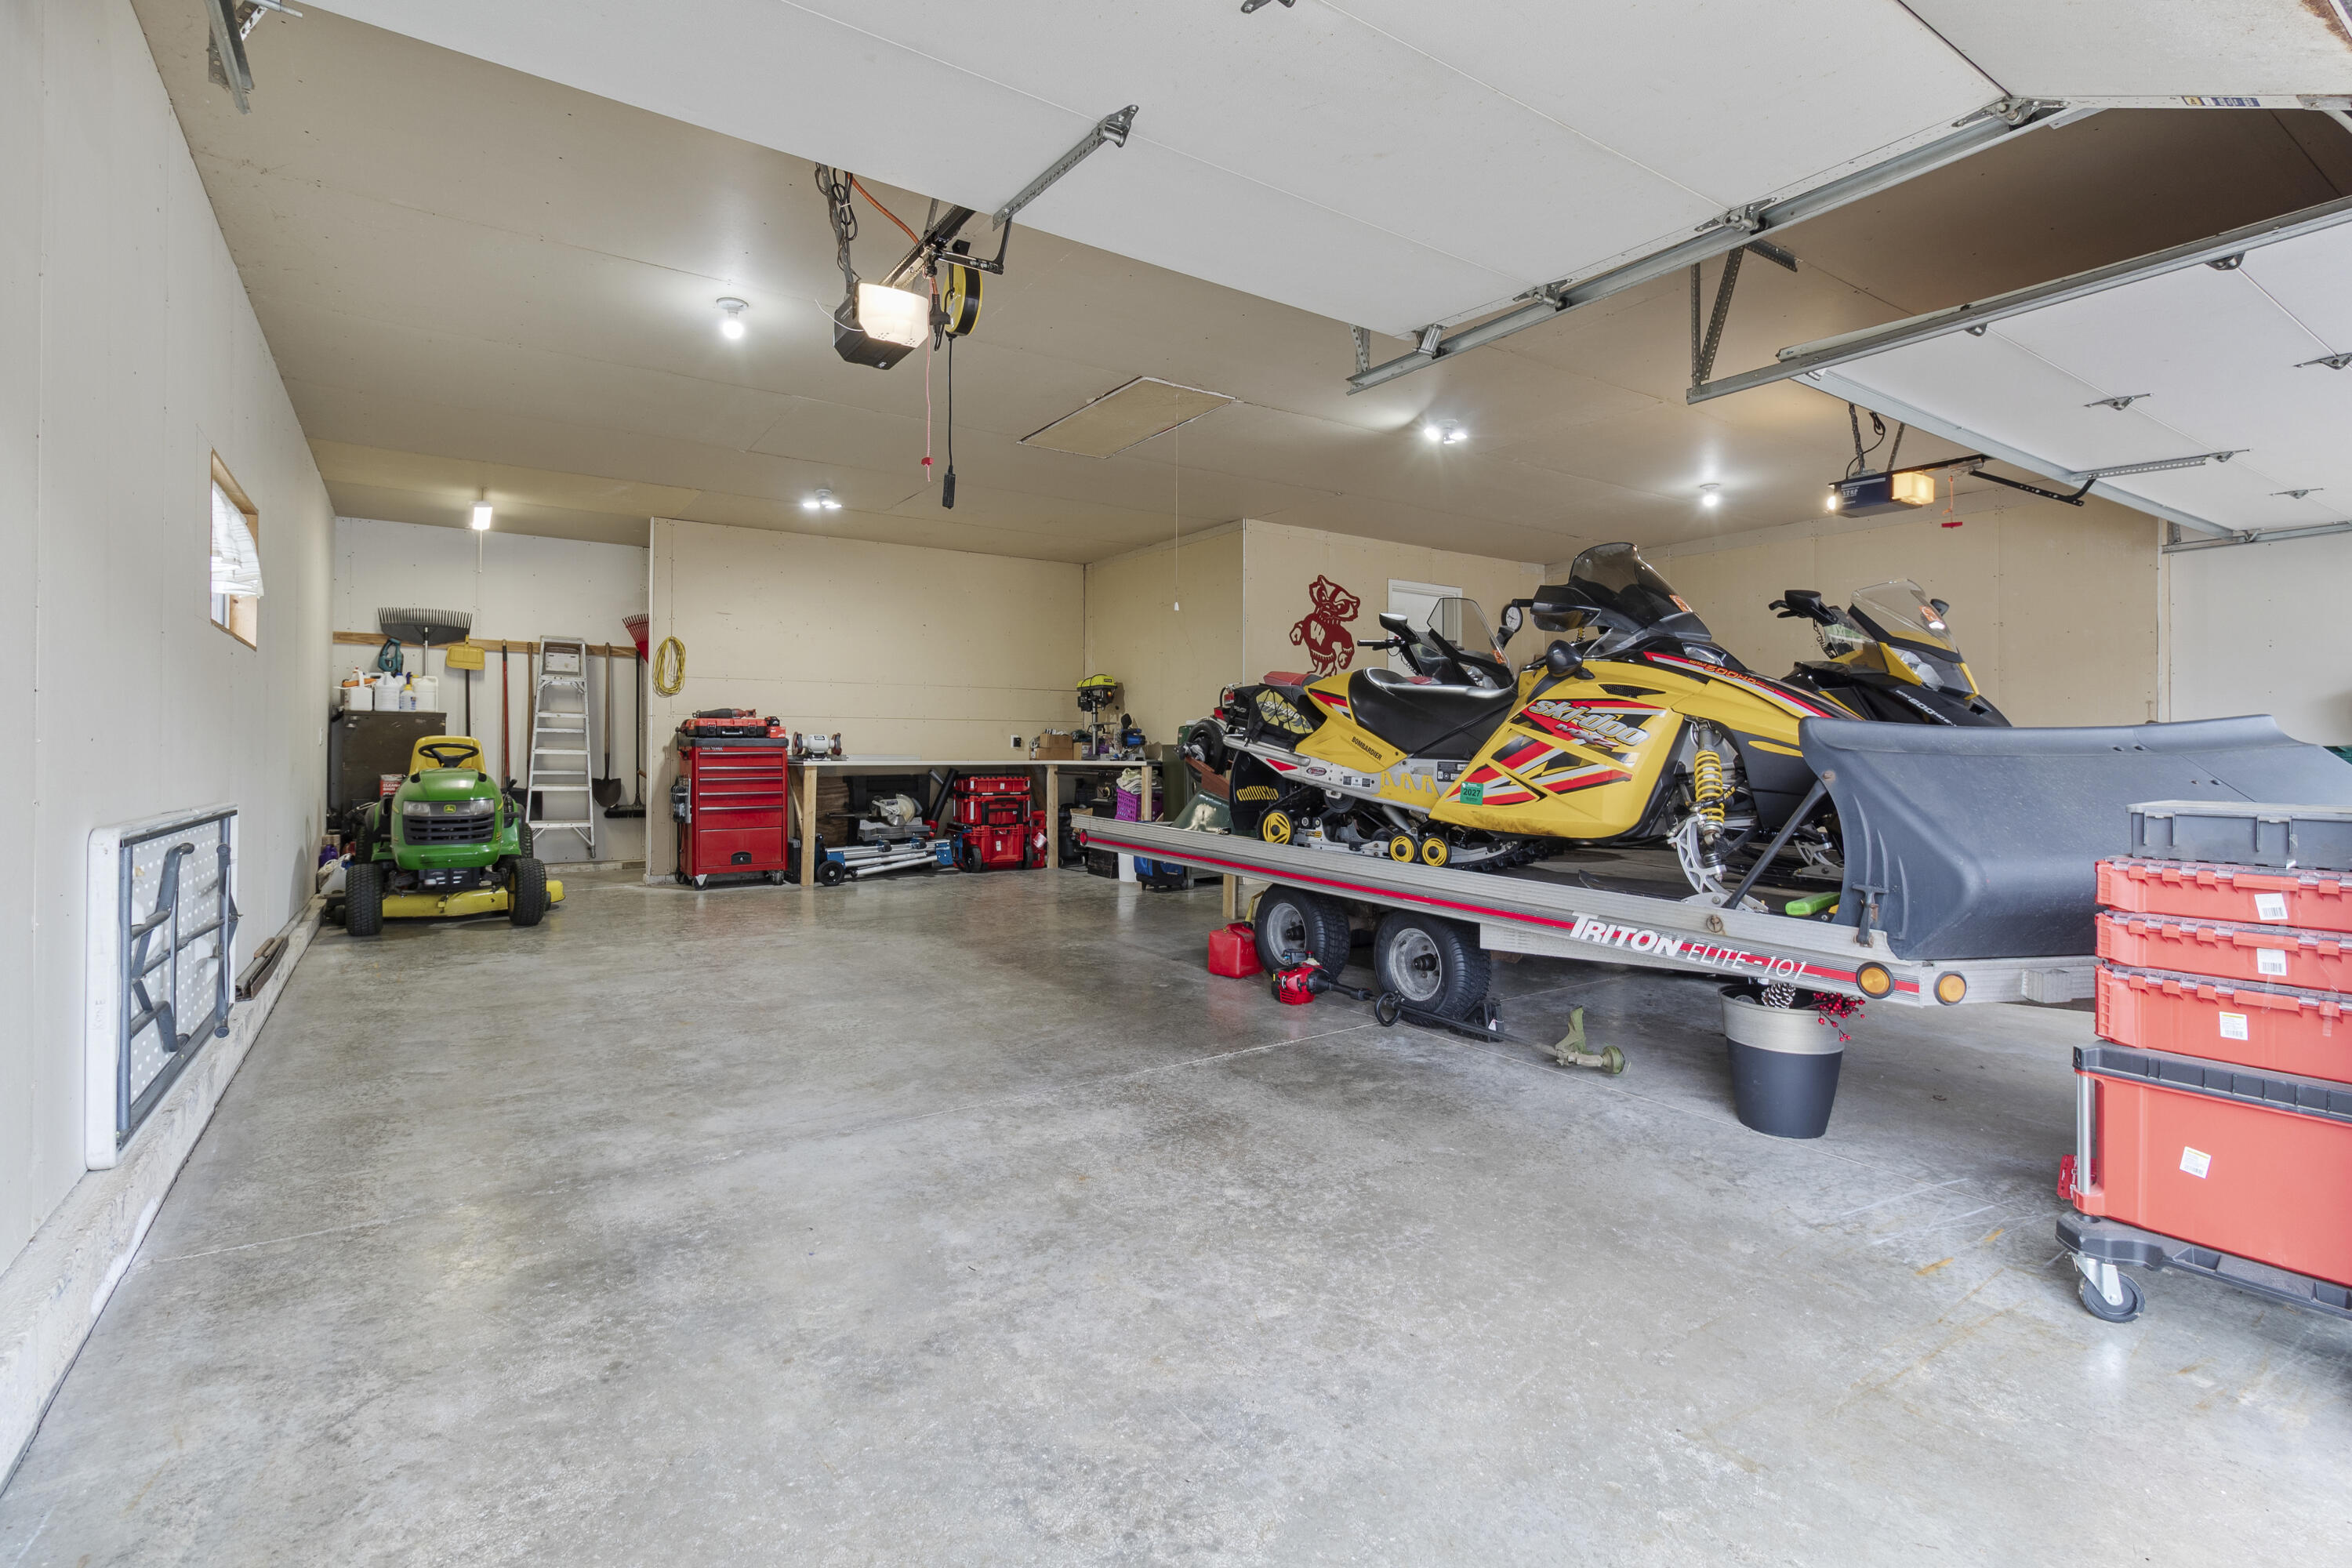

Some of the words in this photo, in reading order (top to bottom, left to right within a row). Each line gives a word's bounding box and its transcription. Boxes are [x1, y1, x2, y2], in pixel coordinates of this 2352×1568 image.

[1310, 620, 1326, 646] W
[1351, 736, 1382, 760] BOMBARDIER
[1463, 788, 1482, 797] 2027
[1570, 912, 1683, 956] TRITON
